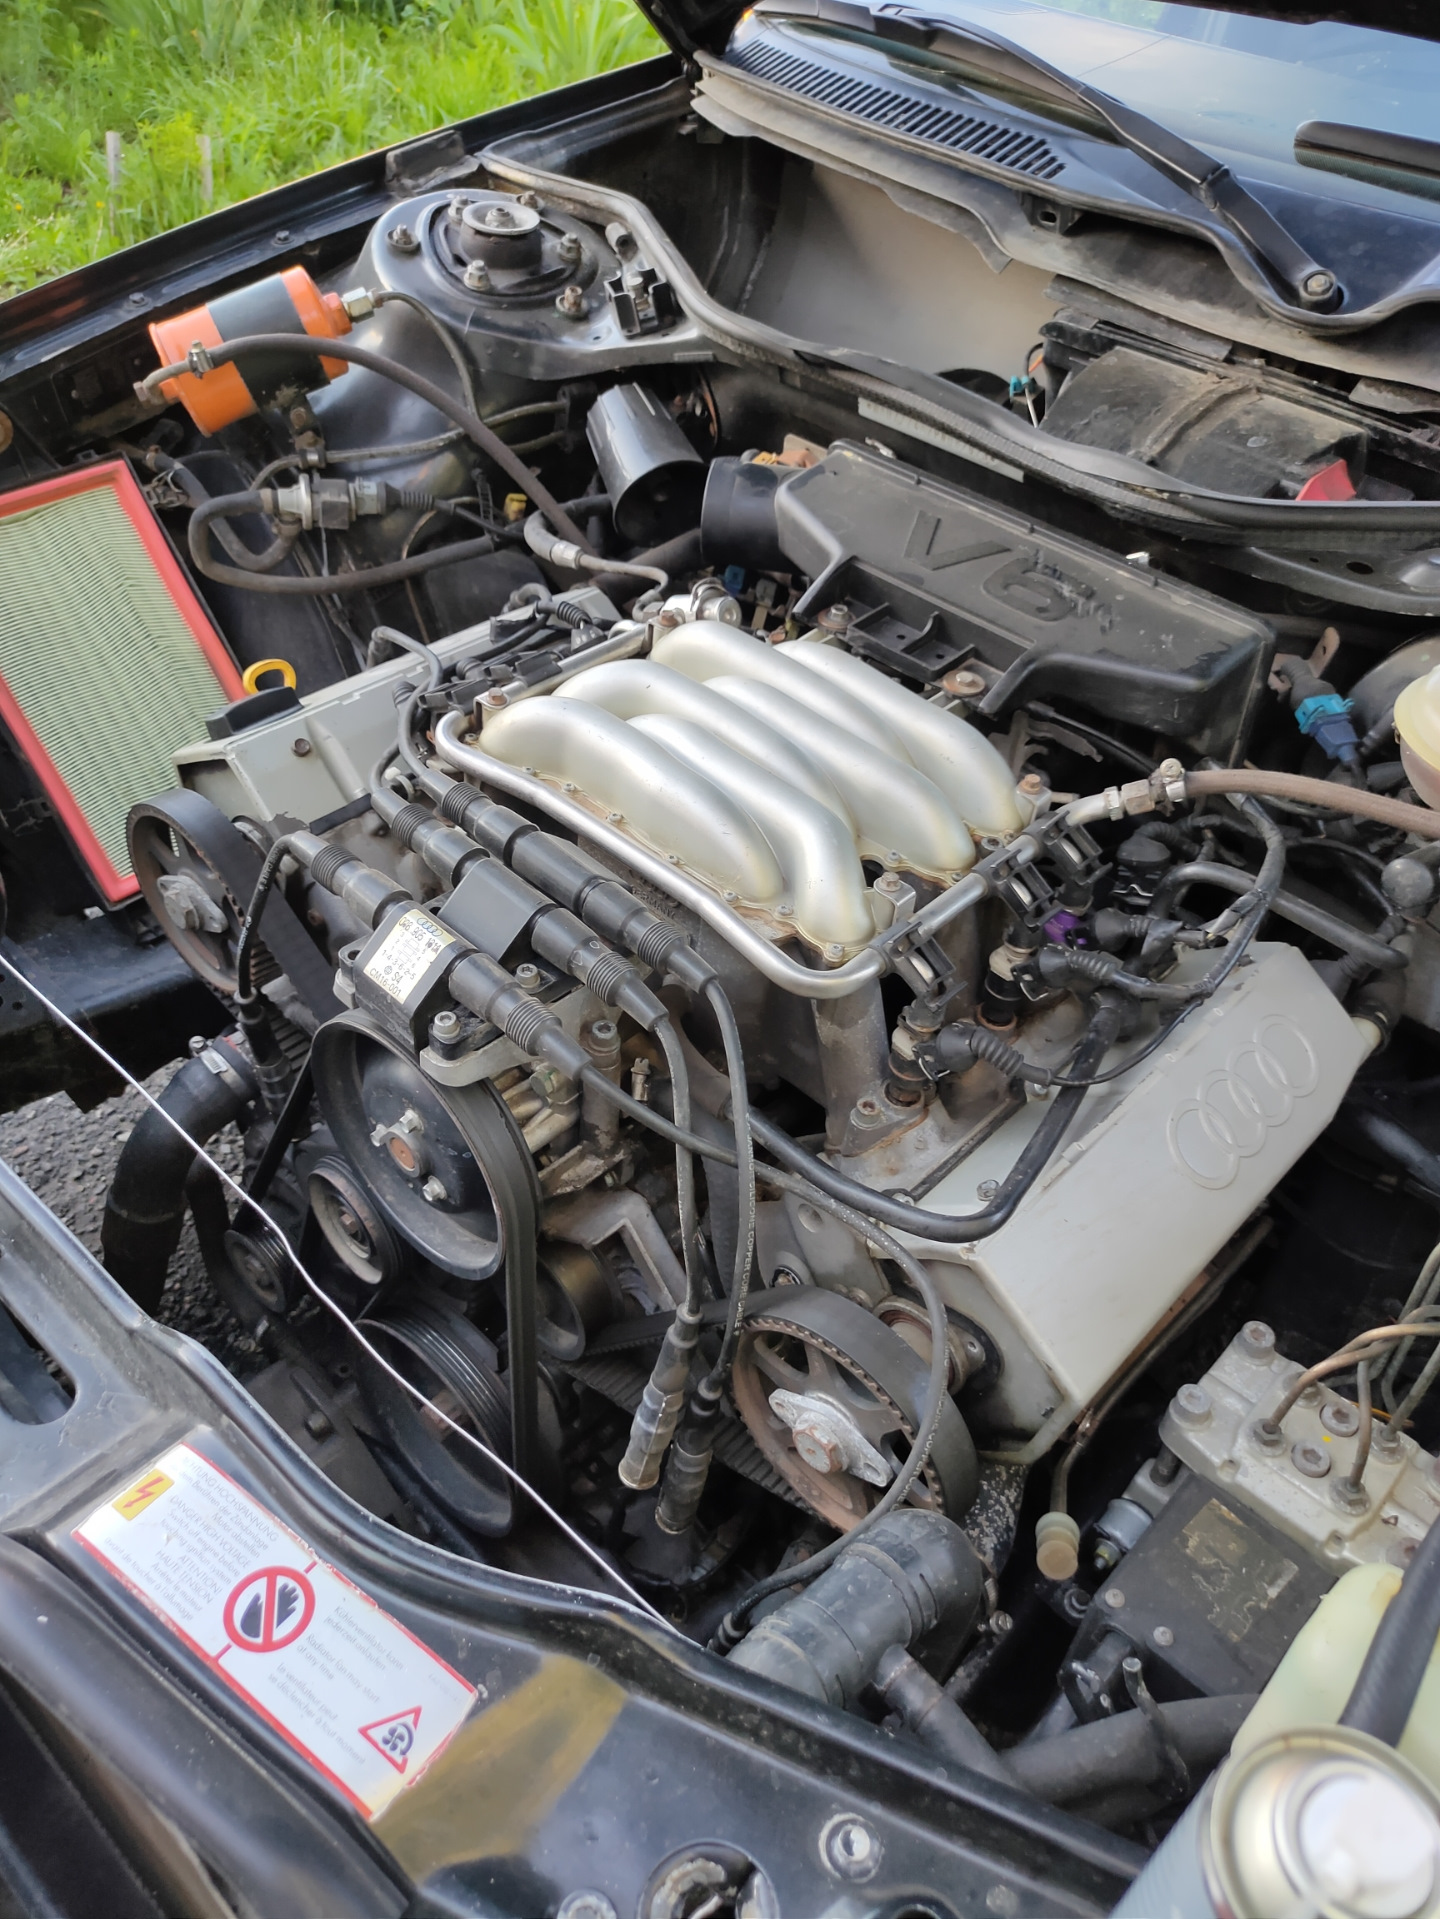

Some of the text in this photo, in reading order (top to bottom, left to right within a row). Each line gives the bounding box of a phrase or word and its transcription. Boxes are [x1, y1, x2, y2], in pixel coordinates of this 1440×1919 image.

[903, 510, 1097, 622] V6
[369, 967, 402, 997] CM16-001
[381, 949, 417, 980] 1-4-3-6-2-5
[743, 1230, 755, 1271] COPPER
[739, 1272, 750, 1299] CORE
[734, 1300, 746, 1328] CABLE
[212, 1483, 281, 1543] HOCHSPANNUNG
[217, 1502, 233, 1517] der
[168, 1494, 252, 1568] DANGER HIGH VOLTAGE
[210, 1512, 263, 1559] Motor abstellen
[154, 1549, 214, 1604] HAUTE TENSION
[193, 1534, 222, 1560] engine
[217, 1553, 243, 1577] before
